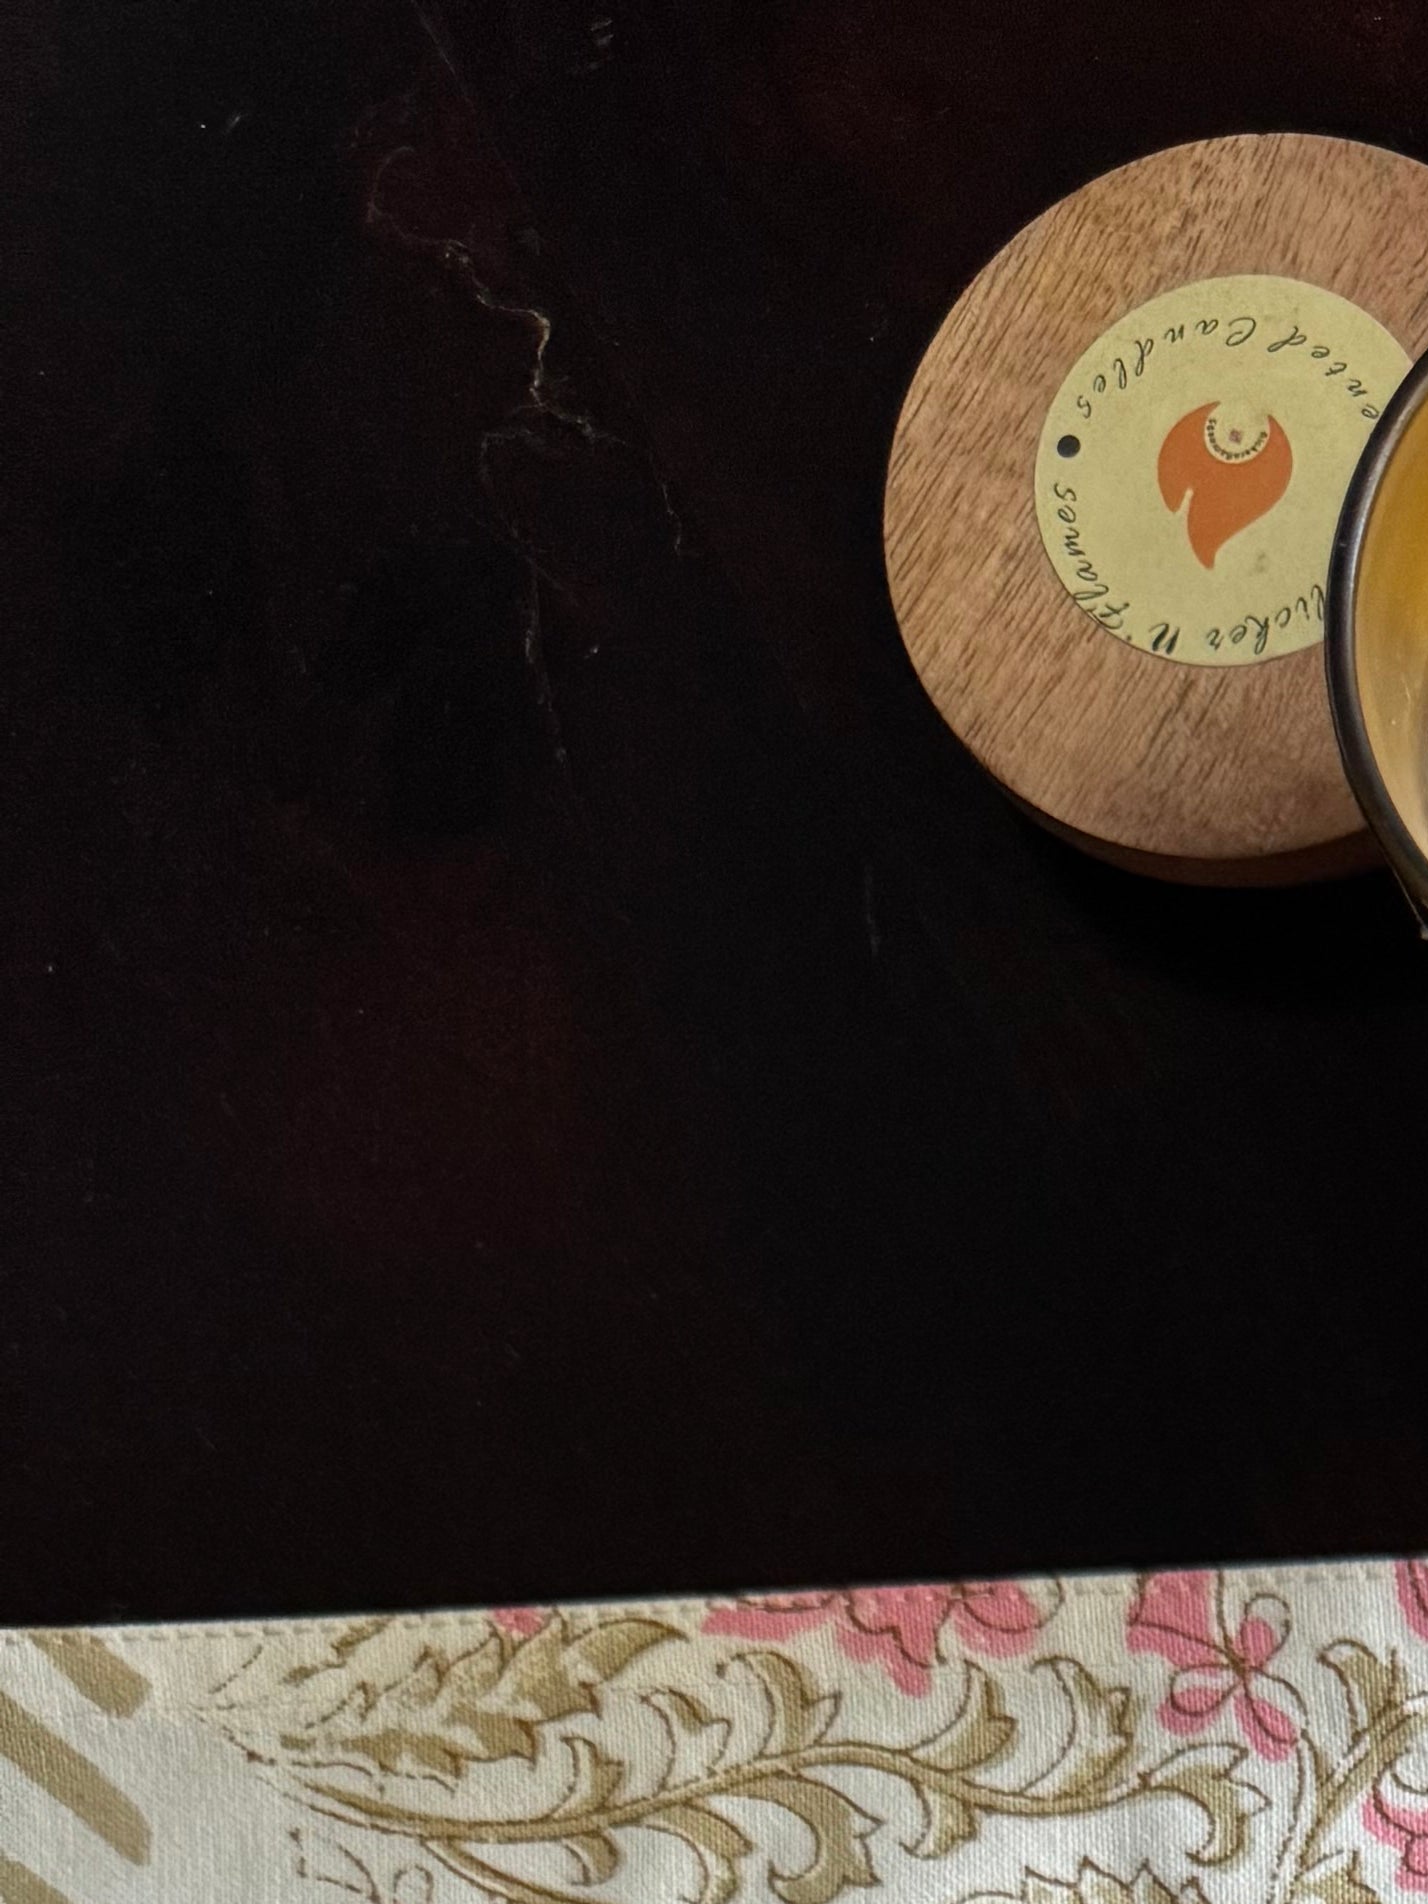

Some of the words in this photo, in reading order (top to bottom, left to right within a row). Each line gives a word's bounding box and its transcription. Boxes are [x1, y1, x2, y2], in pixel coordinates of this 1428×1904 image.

[1074, 315, 1257, 420] Candles
[1266, 324, 1381, 422] ented
[1206, 583, 1327, 656] licker
